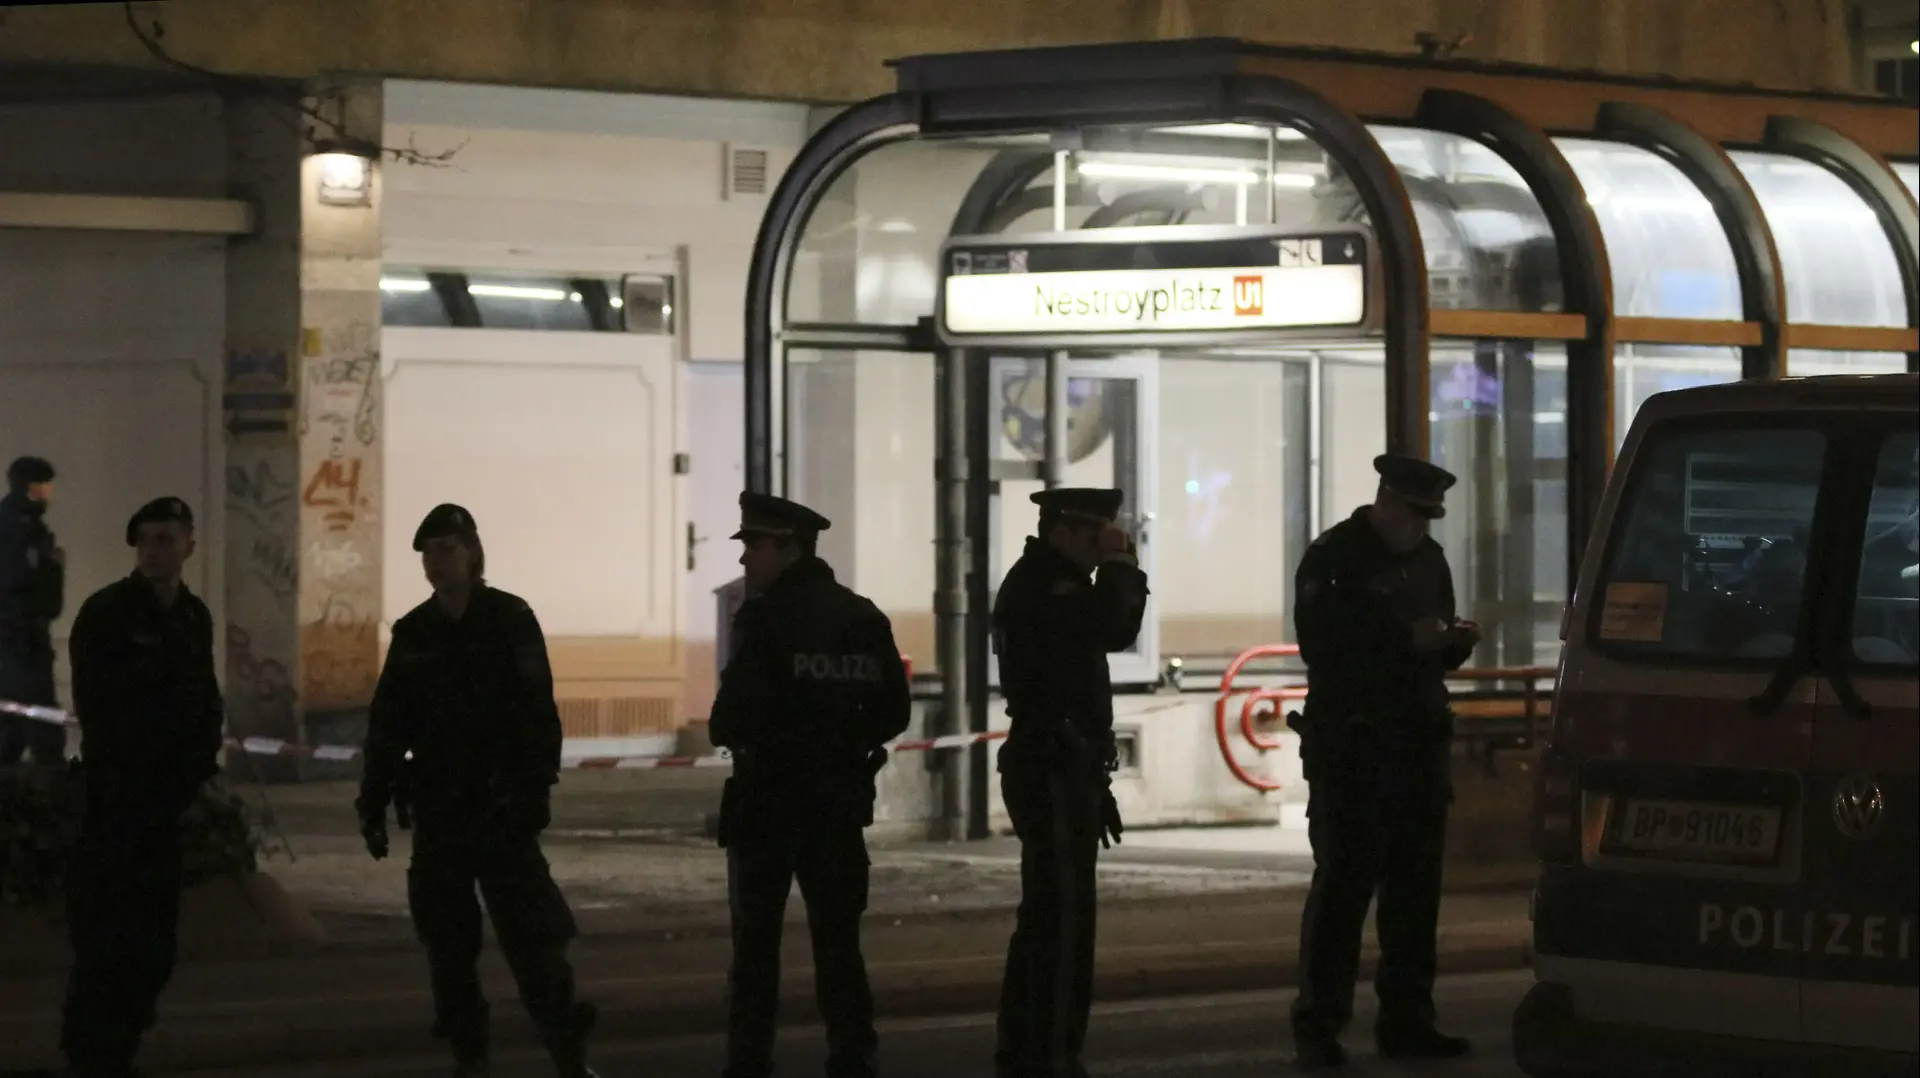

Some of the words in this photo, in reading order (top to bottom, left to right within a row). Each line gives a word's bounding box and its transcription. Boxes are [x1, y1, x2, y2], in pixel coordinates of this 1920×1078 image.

[1035, 279, 1222, 320] Nestroyplatz
[1235, 281, 1261, 309] U1
[1633, 806, 1667, 838] BP
[1699, 902, 1914, 960] POLIZEI
